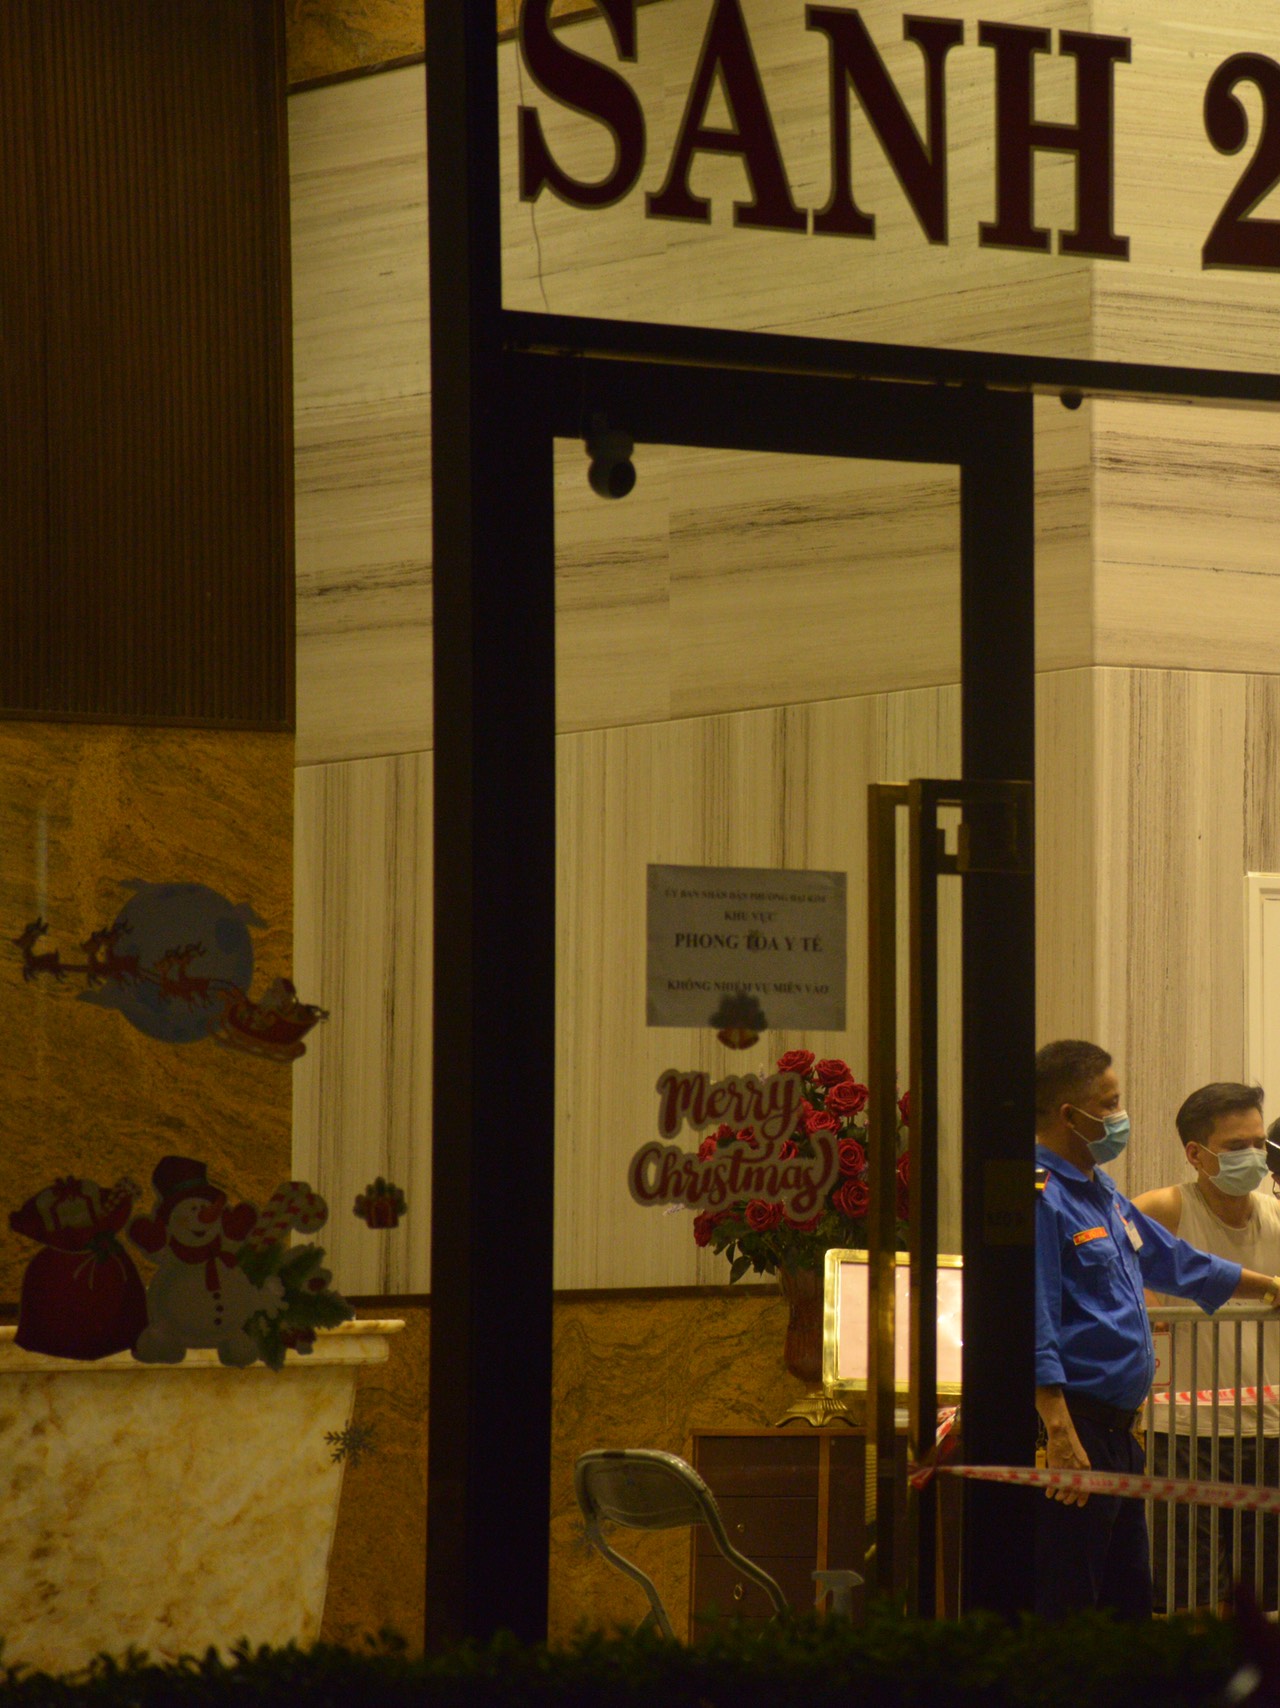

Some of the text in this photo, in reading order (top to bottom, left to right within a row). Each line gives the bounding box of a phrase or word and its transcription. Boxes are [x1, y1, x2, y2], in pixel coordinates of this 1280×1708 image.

[724, 910, 747, 921] KHU
[675, 933, 739, 950] PHONG
[785, 937, 796, 951] Y
[801, 934, 824, 952] TẾ
[667, 978, 711, 991] KHÔNG
[660, 1071, 802, 1143] Merry
[633, 1137, 834, 1213] Christmas
